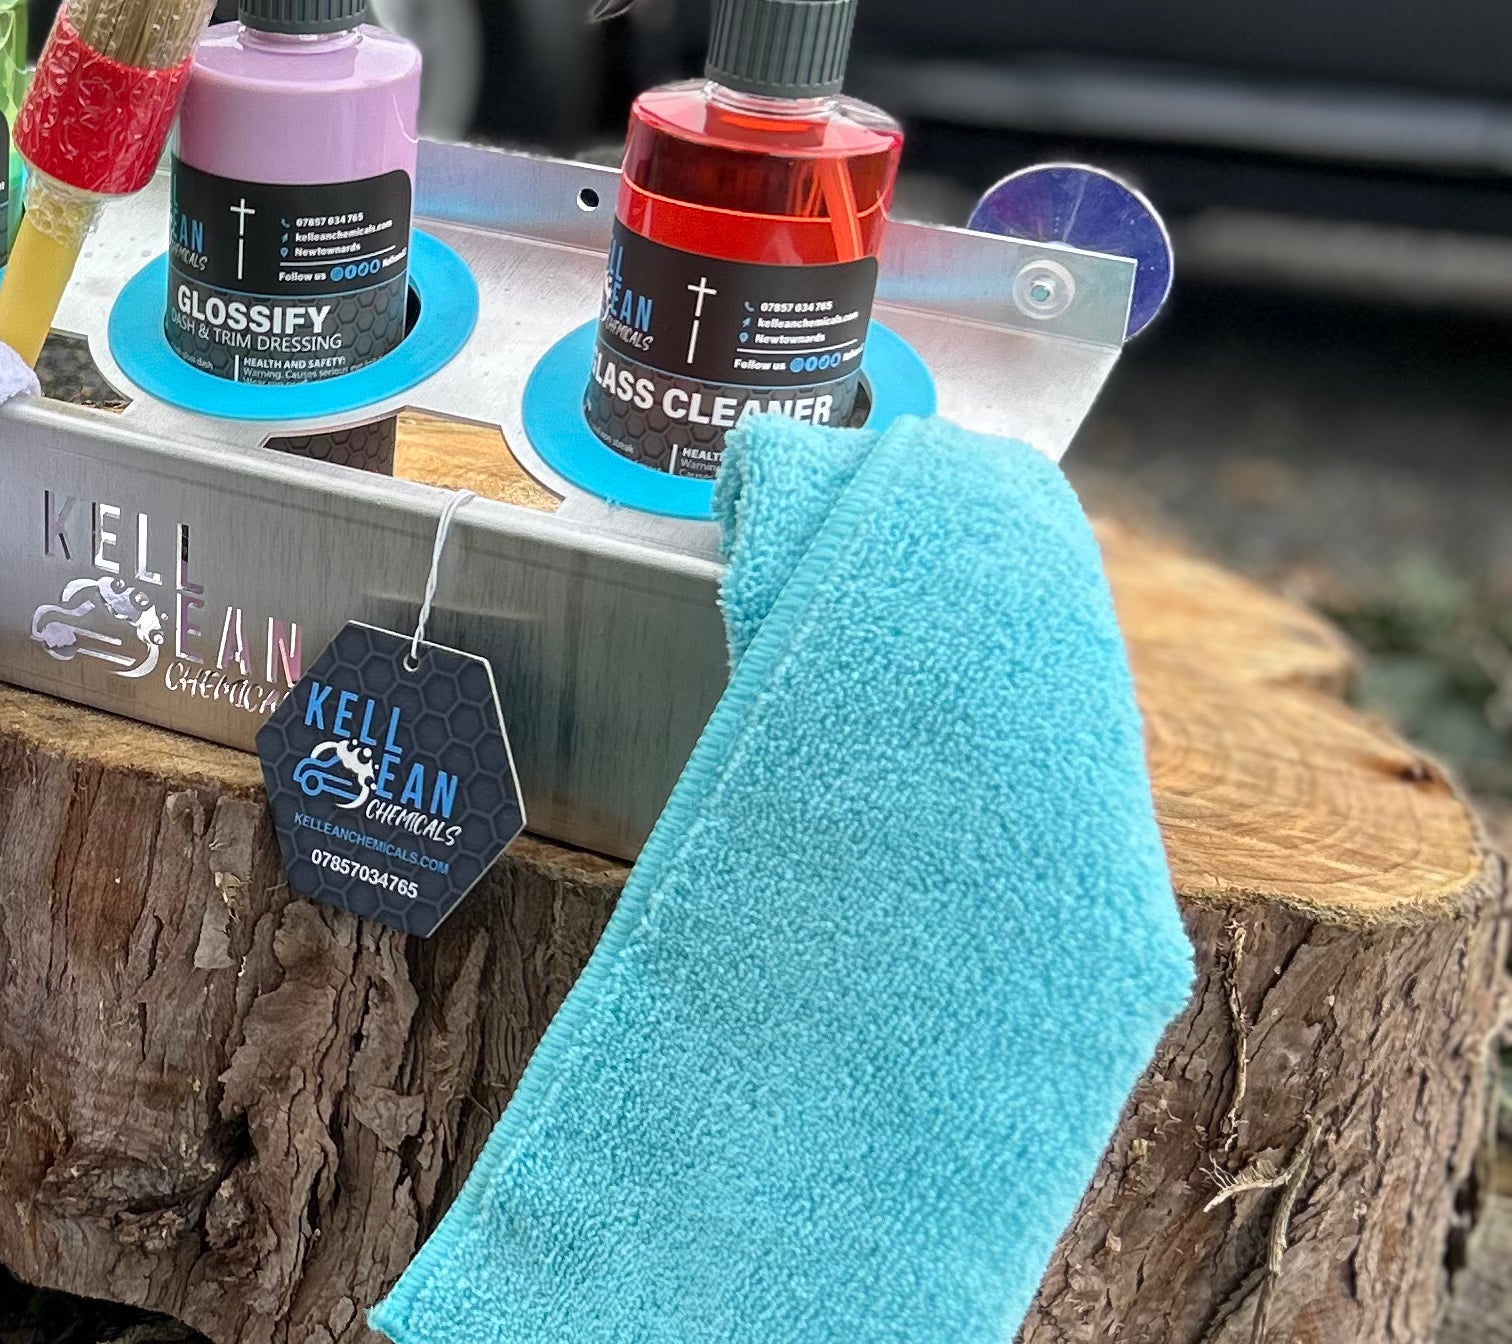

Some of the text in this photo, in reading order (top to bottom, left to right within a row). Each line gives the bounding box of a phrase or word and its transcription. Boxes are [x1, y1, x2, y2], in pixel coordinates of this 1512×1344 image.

[278, 271, 313, 282] Follow
[171, 308, 342, 352] DASH & TRIM DRESSING
[178, 284, 331, 334] GLOSSIFY
[243, 357, 282, 369] HEALTH
[283, 360, 306, 369] AND
[733, 358, 771, 370] Follow
[44, 490, 204, 595] KELL
[175, 592, 303, 688] EAN
[304, 681, 403, 755] KELL
[375, 754, 458, 818] EAN
[294, 812, 450, 875] KELLEANCHEMICALS.COM
[365, 798, 462, 846] CHEMICALS
[311, 848, 419, 899] 07857034765
